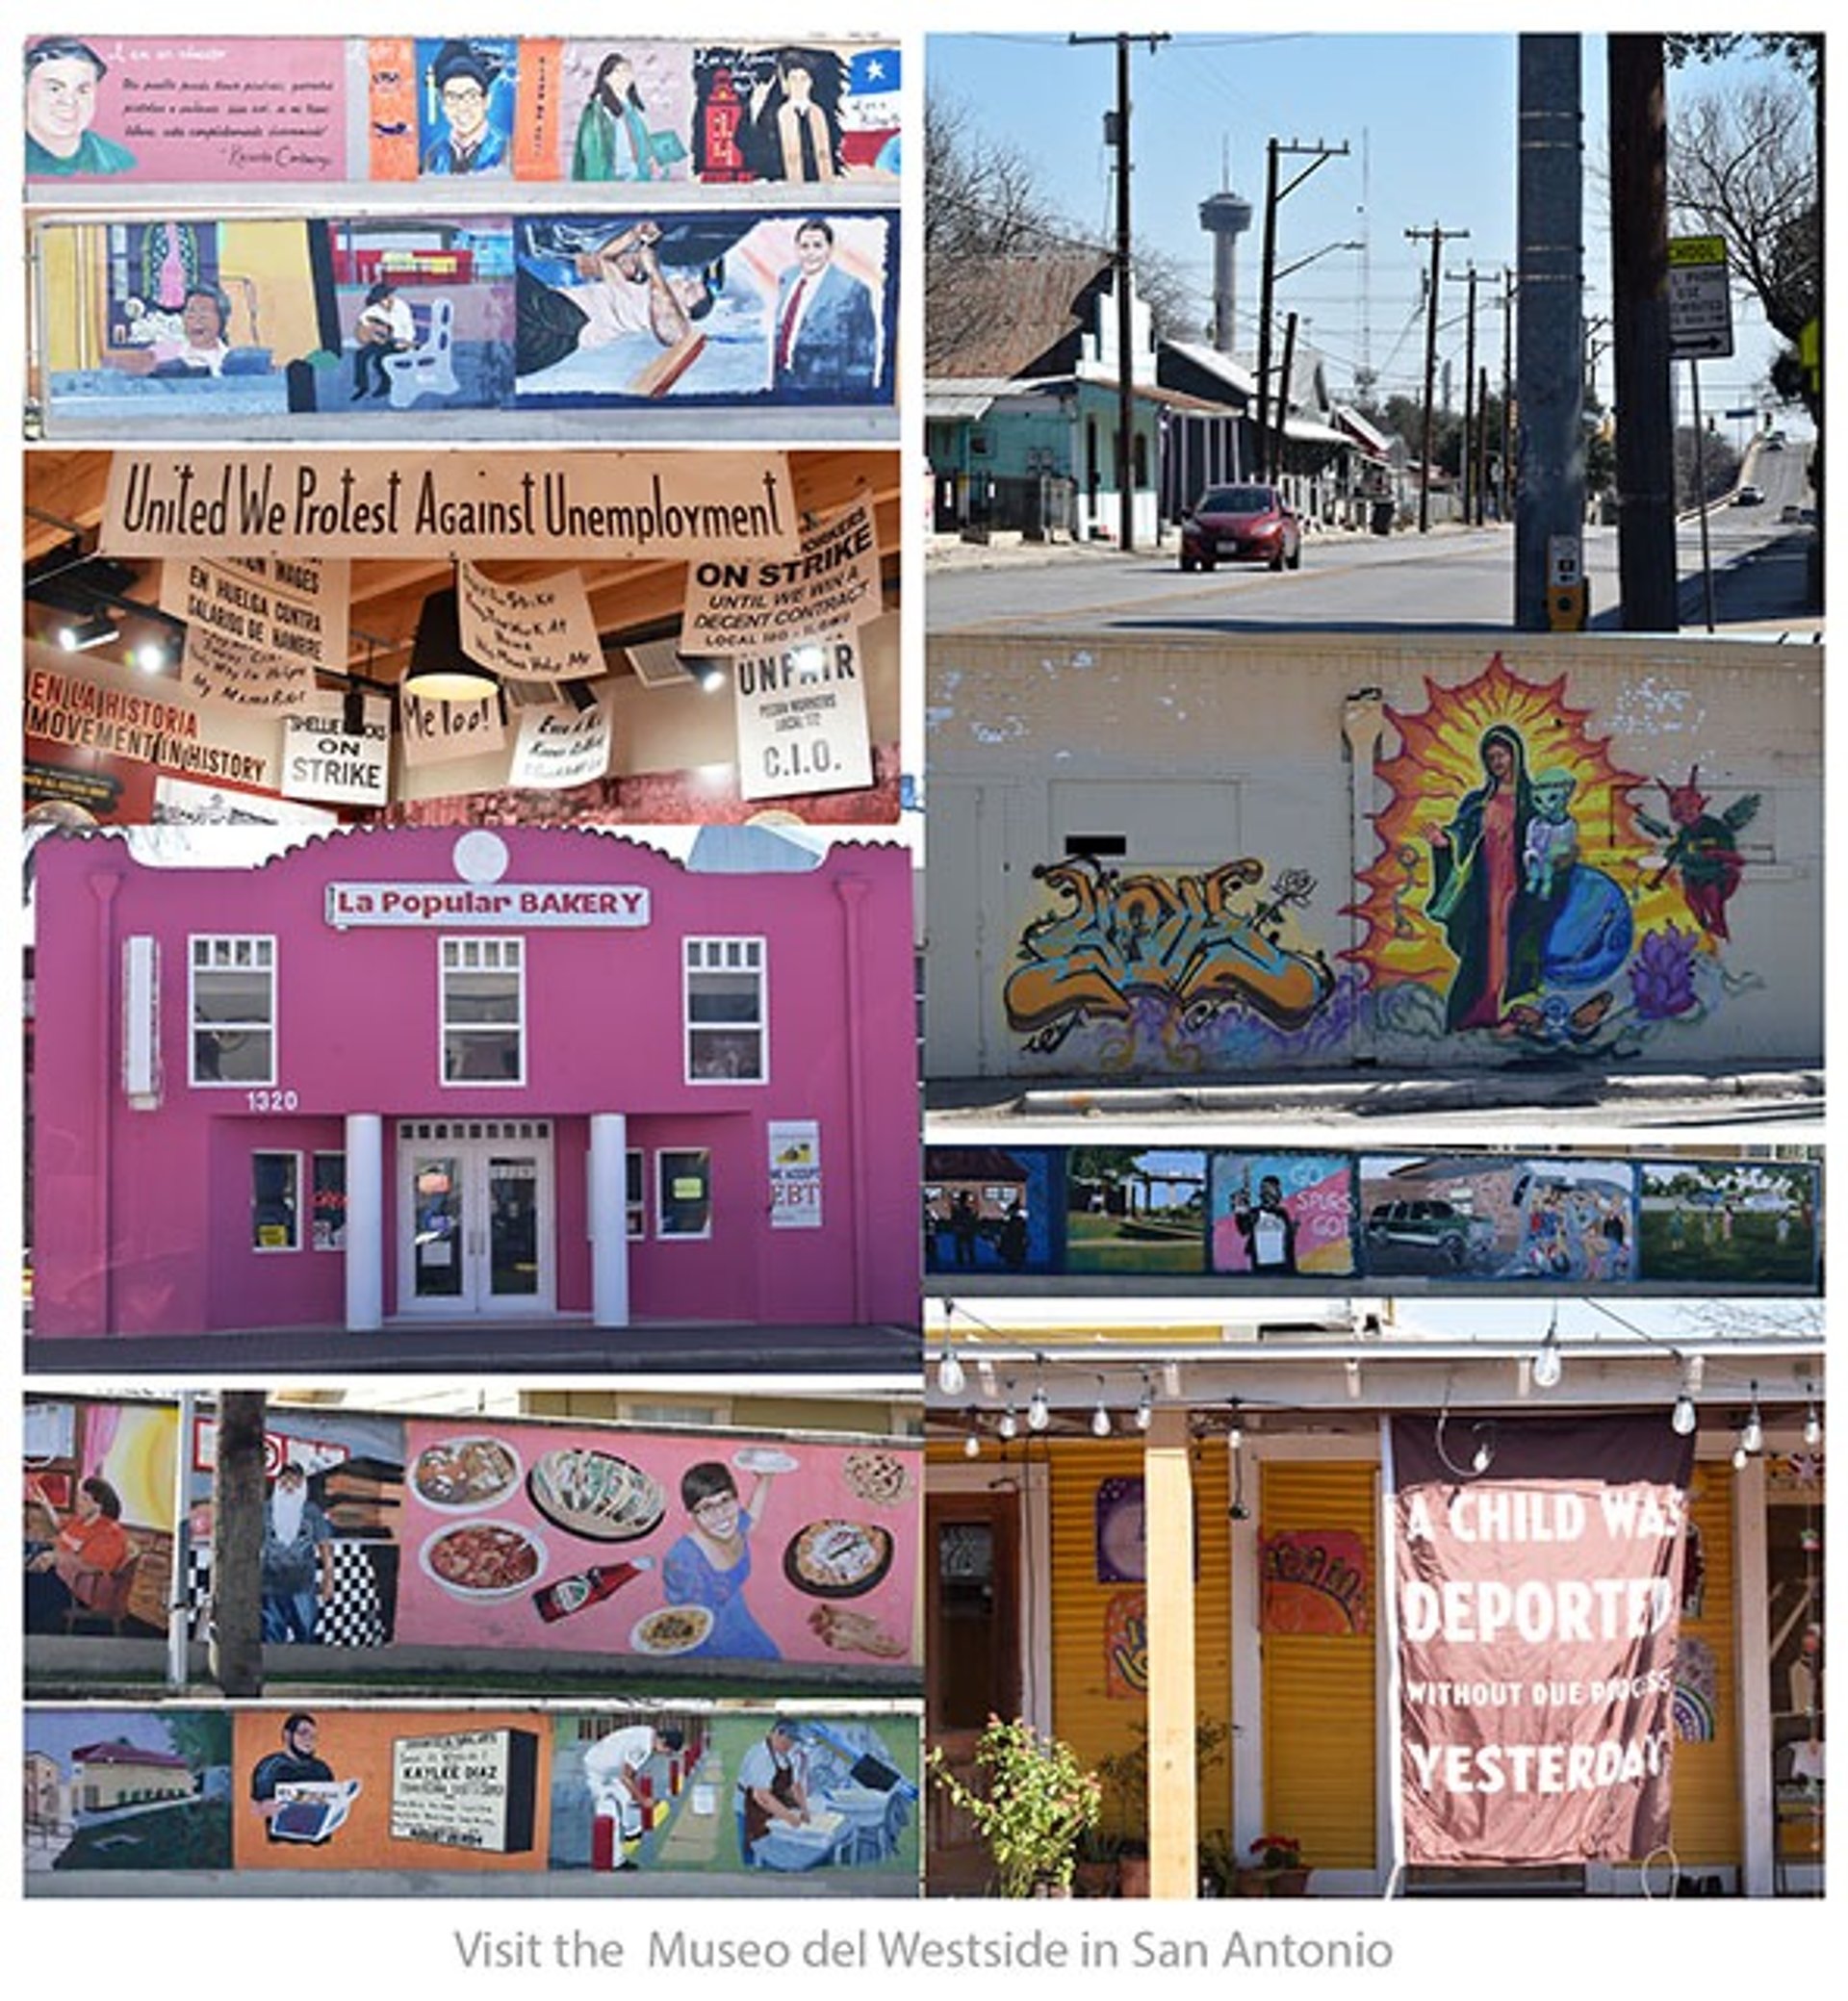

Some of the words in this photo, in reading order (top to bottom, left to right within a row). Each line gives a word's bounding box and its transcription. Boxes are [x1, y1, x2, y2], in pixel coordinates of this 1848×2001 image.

[123, 462, 231, 533] United
[239, 462, 286, 535] We
[294, 466, 402, 535] Protest
[415, 470, 534, 535] Against
[544, 472, 784, 544] Unemployment
[696, 563, 749, 587] ON
[758, 523, 873, 586] STRIKE
[693, 612, 771, 630] DECENT
[774, 579, 870, 626] CONTRACT
[708, 595, 768, 609] UNTIL
[31, 672, 63, 703] EN
[71, 680, 94, 713] LA
[105, 688, 199, 739] HISTORIA
[31, 706, 156, 761] MOVEMENT
[161, 736, 181, 765] IN
[187, 742, 266, 782] HISTORY
[319, 737, 360, 757] ON
[764, 739, 842, 778] C.I.O.
[293, 757, 381, 788] STRIKE
[339, 891, 372, 913] La
[381, 891, 511, 919] Popular
[521, 893, 643, 913] BAKERY
[245, 1090, 298, 1111] 1320
[771, 1180, 820, 1205] EBT
[1289, 1163, 1323, 1188] GO
[1407, 1493, 1435, 1540] A
[1450, 1492, 1586, 1542] CHILD
[1600, 1487, 1683, 1540] WAS
[1404, 1578, 1673, 1643] DEPORTED
[1405, 1680, 1525, 1706] WITHOUT
[1532, 1682, 1581, 1706] DUE
[1406, 1730, 1668, 1793] YESTERDAY
